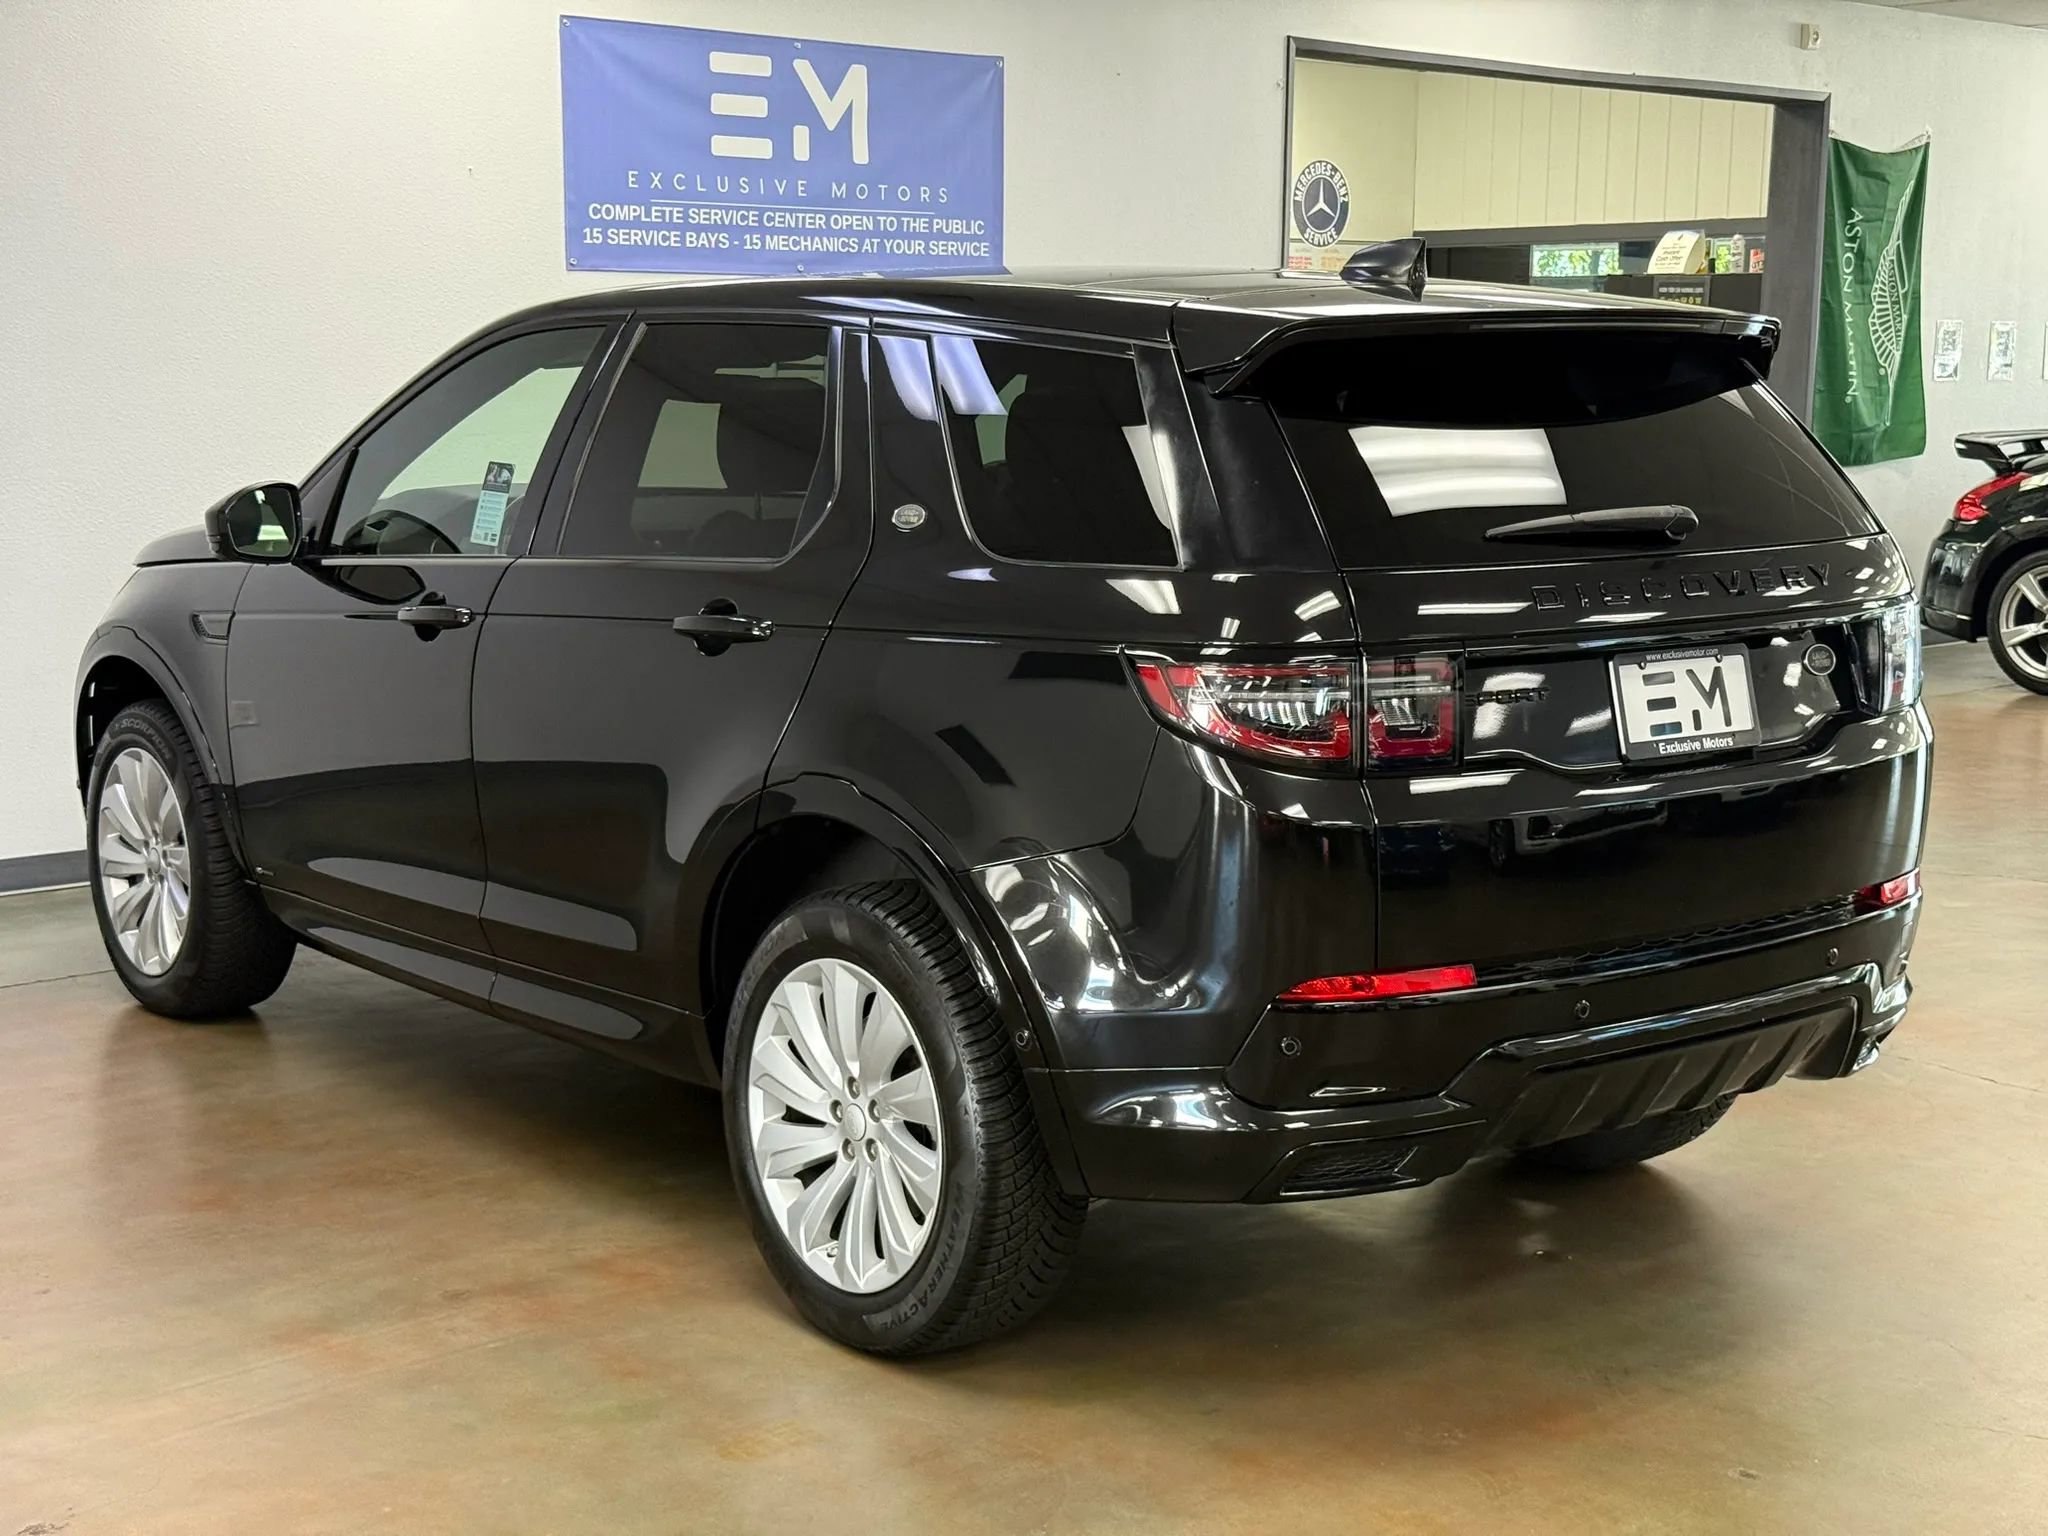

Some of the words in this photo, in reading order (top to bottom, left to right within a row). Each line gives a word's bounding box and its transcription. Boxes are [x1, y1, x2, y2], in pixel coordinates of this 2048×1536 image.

[709, 50, 870, 164] EM
[628, 170, 808, 197] EXCLUSIVE
[831, 182, 948, 203] MOTORS
[588, 203, 684, 223] COMPLETE
[688, 207, 759, 226] SERVICE
[763, 211, 826, 229] CENTER
[830, 214, 874, 231] OPEN
[877, 216, 897, 231] TO
[901, 217, 930, 233] THE
[933, 219, 985, 235] PUBLIC
[583, 227, 603, 244] 15
[607, 229, 681, 247] SERVICE
[686, 231, 730, 249] BAYS
[743, 234, 761, 250] 15
[765, 235, 859, 253] MECHANICS
[862, 238, 880, 253] AT
[884, 239, 925, 255] YOUR
[929, 241, 990, 257] SERVICE
[1303, 227, 1338, 246] SERVICE
[1842, 207, 1864, 293] ASTON
[1886, 262, 1899, 301] ASTON
[1530, 562, 1830, 610] DISCOVERY
[1646, 648, 1719, 661] www.exclusivemotor.com
[1641, 666, 1732, 737] EM
[1658, 740, 1701, 754] Exclusive
[1702, 737, 1734, 750] Motors
